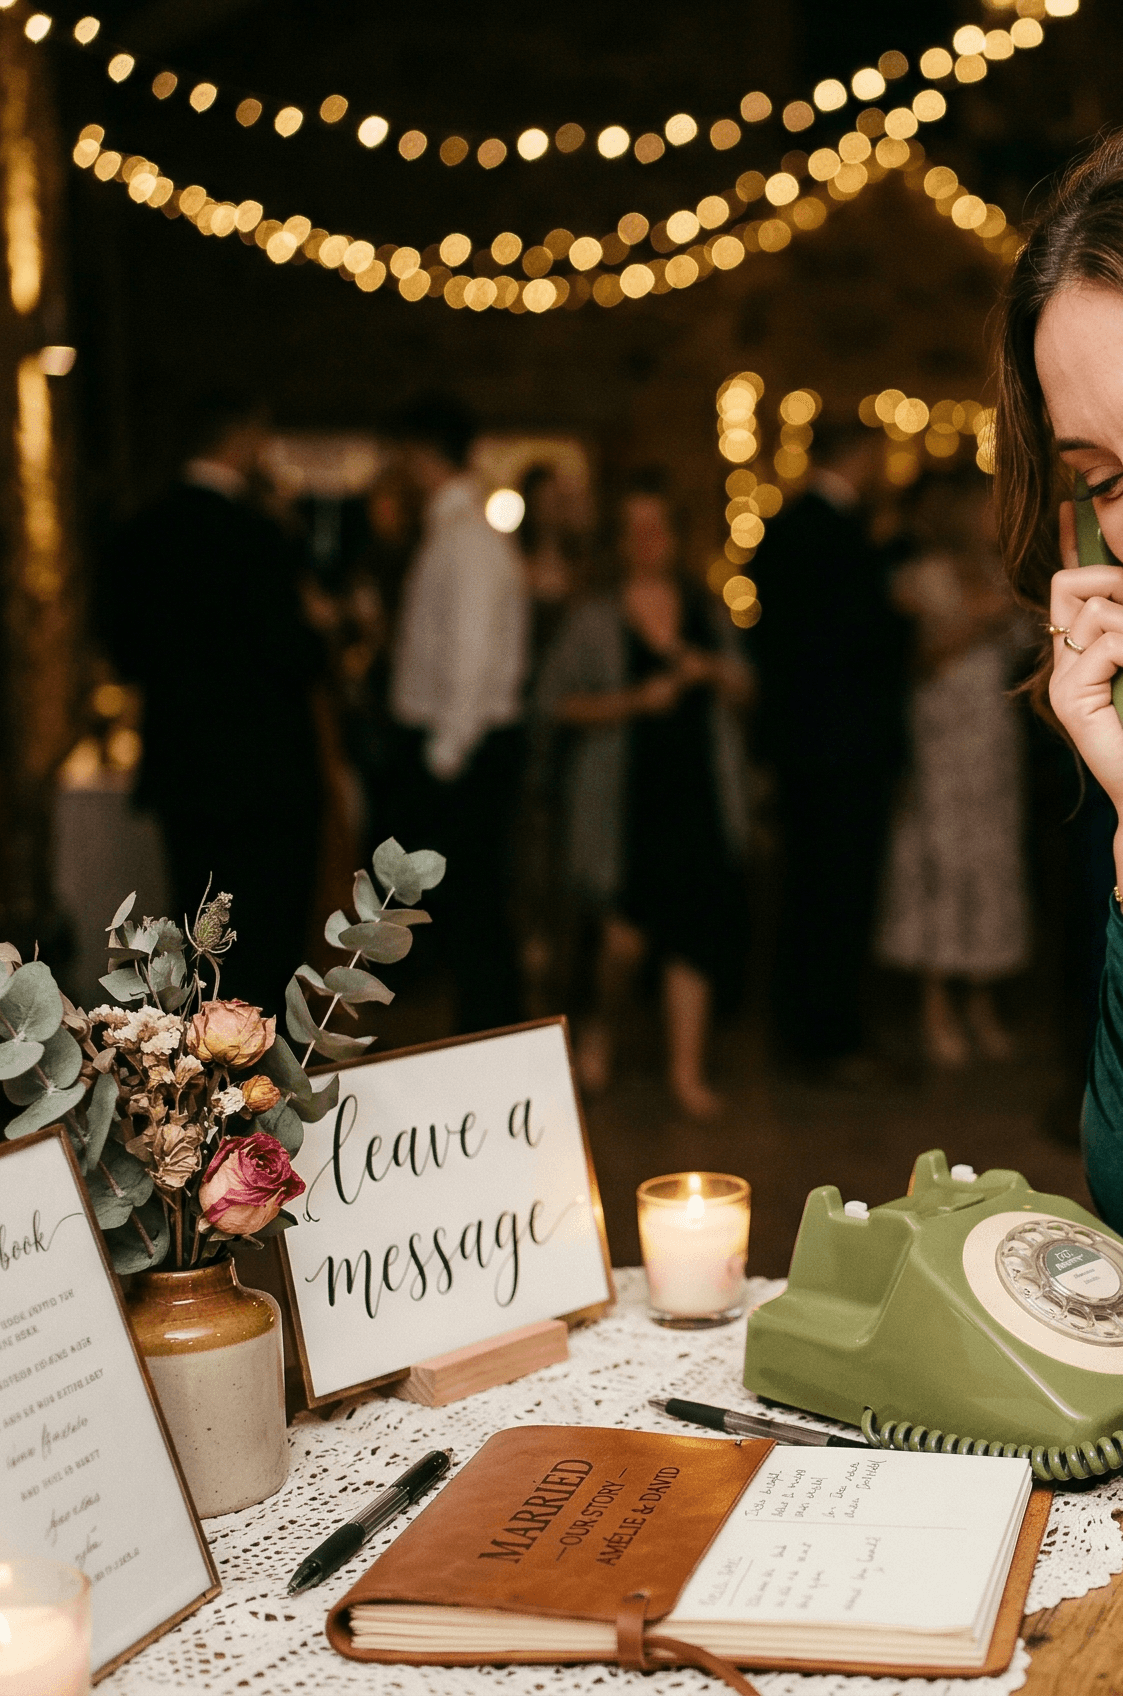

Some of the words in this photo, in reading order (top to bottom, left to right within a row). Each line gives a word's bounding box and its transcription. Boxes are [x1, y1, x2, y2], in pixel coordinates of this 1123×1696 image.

[303, 1094, 488, 1222] leave
[508, 1097, 545, 1148] a
[305, 1199, 579, 1319] message
[477, 1459, 594, 1564] MARRIED
[559, 1519, 599, 1546] OUR
[581, 1480, 626, 1518] STORY
[631, 1503, 657, 1515] &
[638, 1466, 681, 1502] DAVID
[595, 1517, 647, 1567] AMÉLIE
